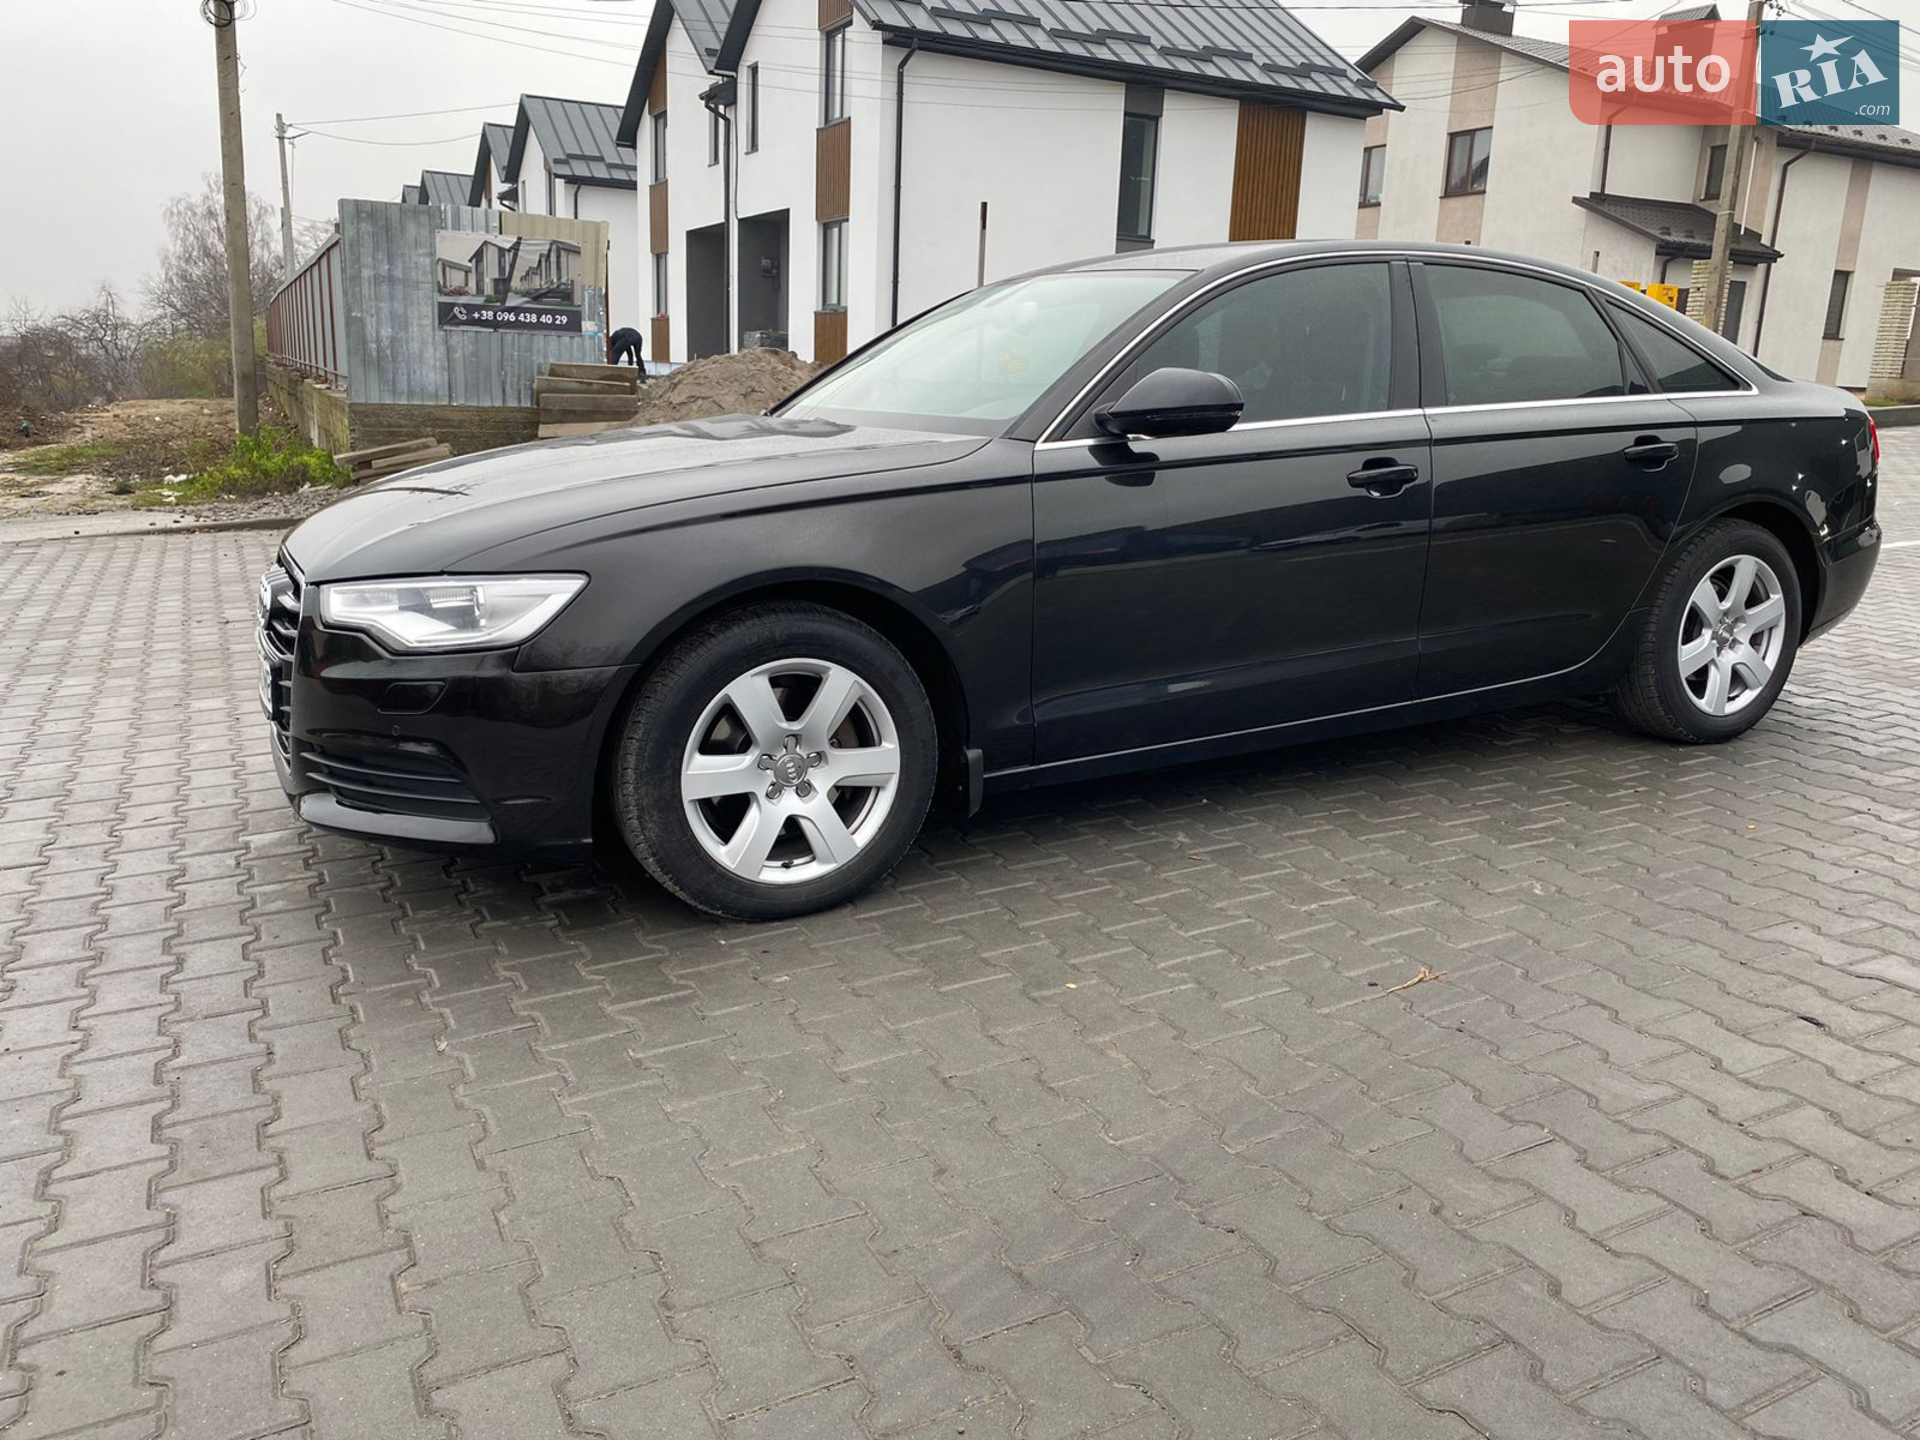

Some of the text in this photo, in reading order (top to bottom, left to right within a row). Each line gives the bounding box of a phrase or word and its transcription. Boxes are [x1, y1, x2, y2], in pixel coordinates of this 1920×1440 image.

[472, 311, 568, 325] +38 096 438 40 29
